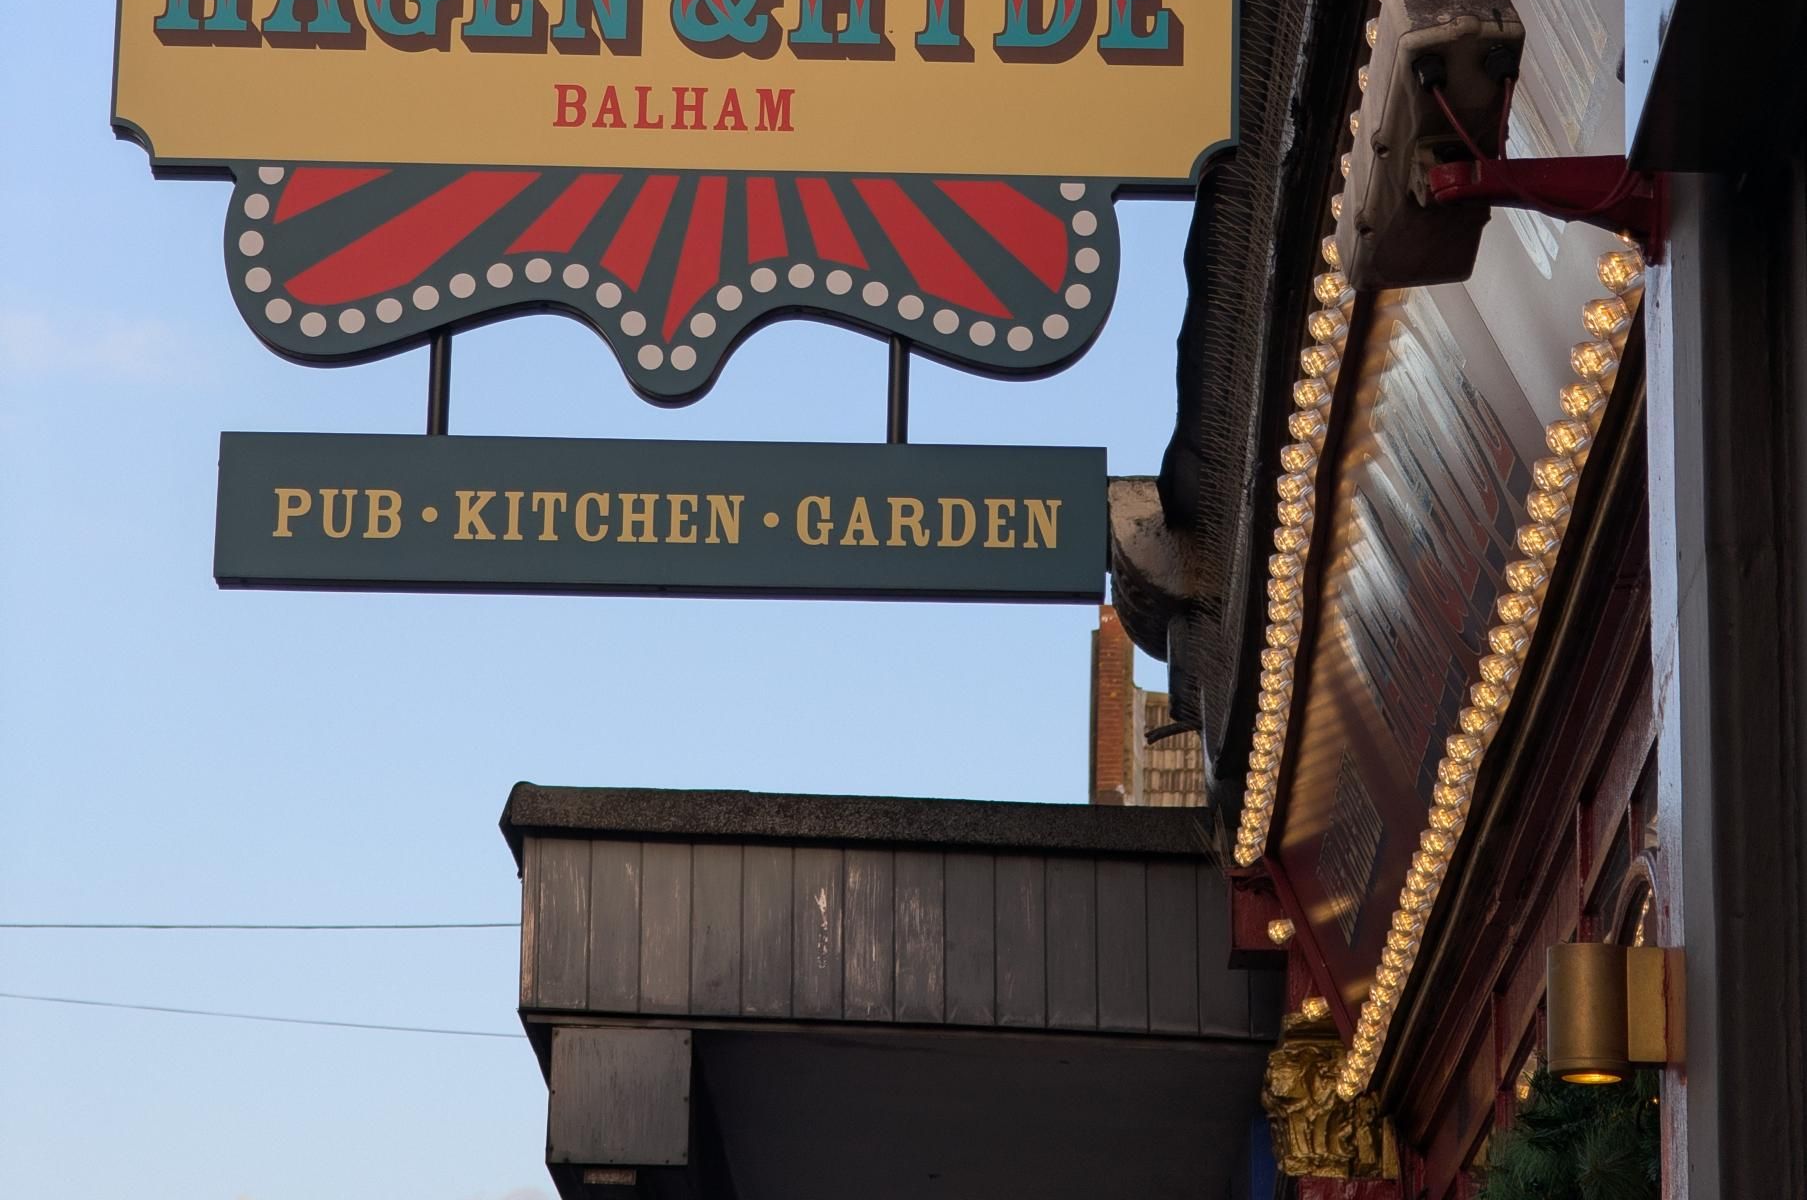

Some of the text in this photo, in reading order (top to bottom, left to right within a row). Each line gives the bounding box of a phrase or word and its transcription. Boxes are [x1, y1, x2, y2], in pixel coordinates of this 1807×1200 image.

[552, 84, 795, 132] BALHAM
[1370, 283, 1535, 635] HYDE
[273, 488, 1061, 549] PUB KITCHEN GARDEN
